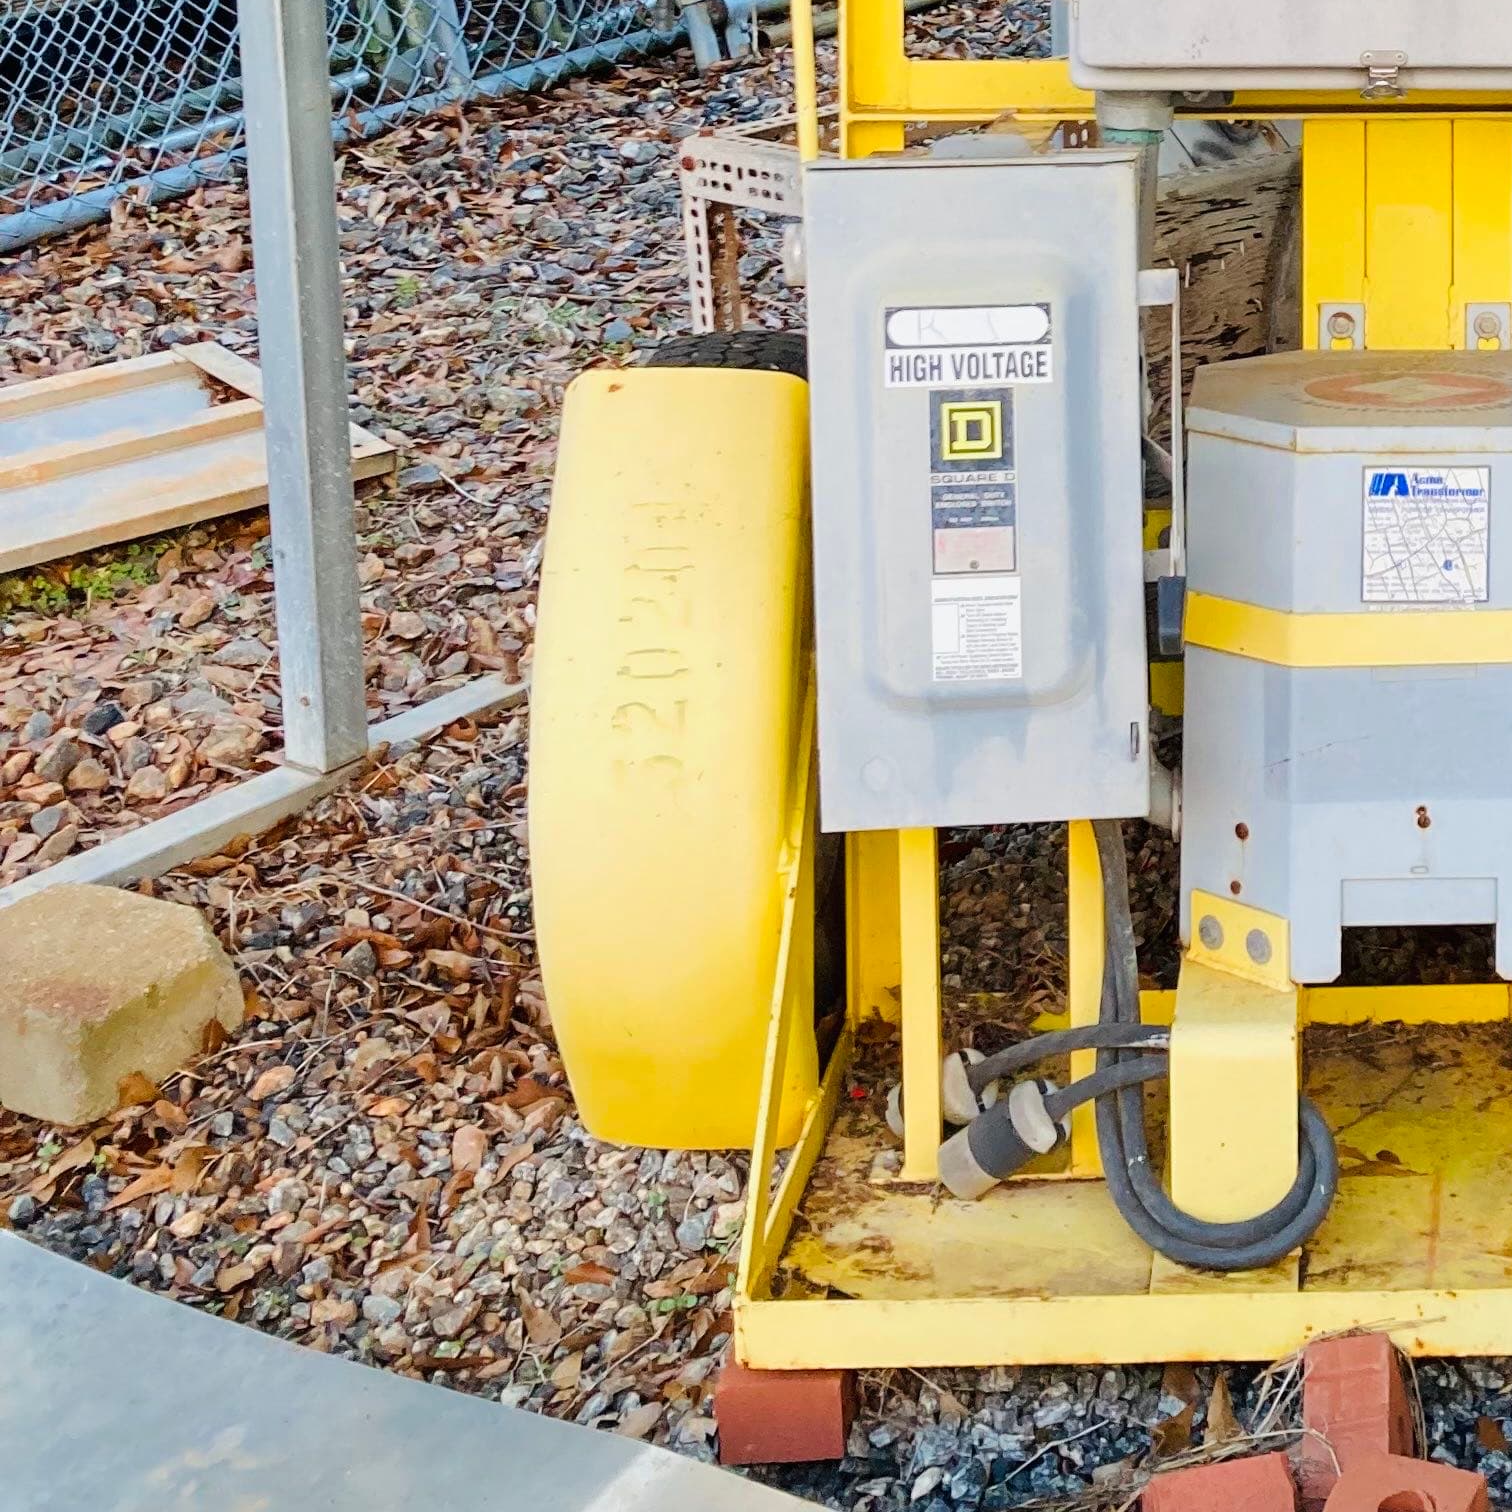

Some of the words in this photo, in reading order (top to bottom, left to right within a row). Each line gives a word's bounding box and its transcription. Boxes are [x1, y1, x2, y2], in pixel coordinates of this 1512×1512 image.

[890, 354, 943, 383] HIGH
[952, 351, 1048, 380] VOLTAGE
[930, 473, 998, 484] SQUARE
[1004, 472, 1016, 481] D
[1411, 472, 1443, 484] Acme
[1411, 484, 1486, 497] Transformer
